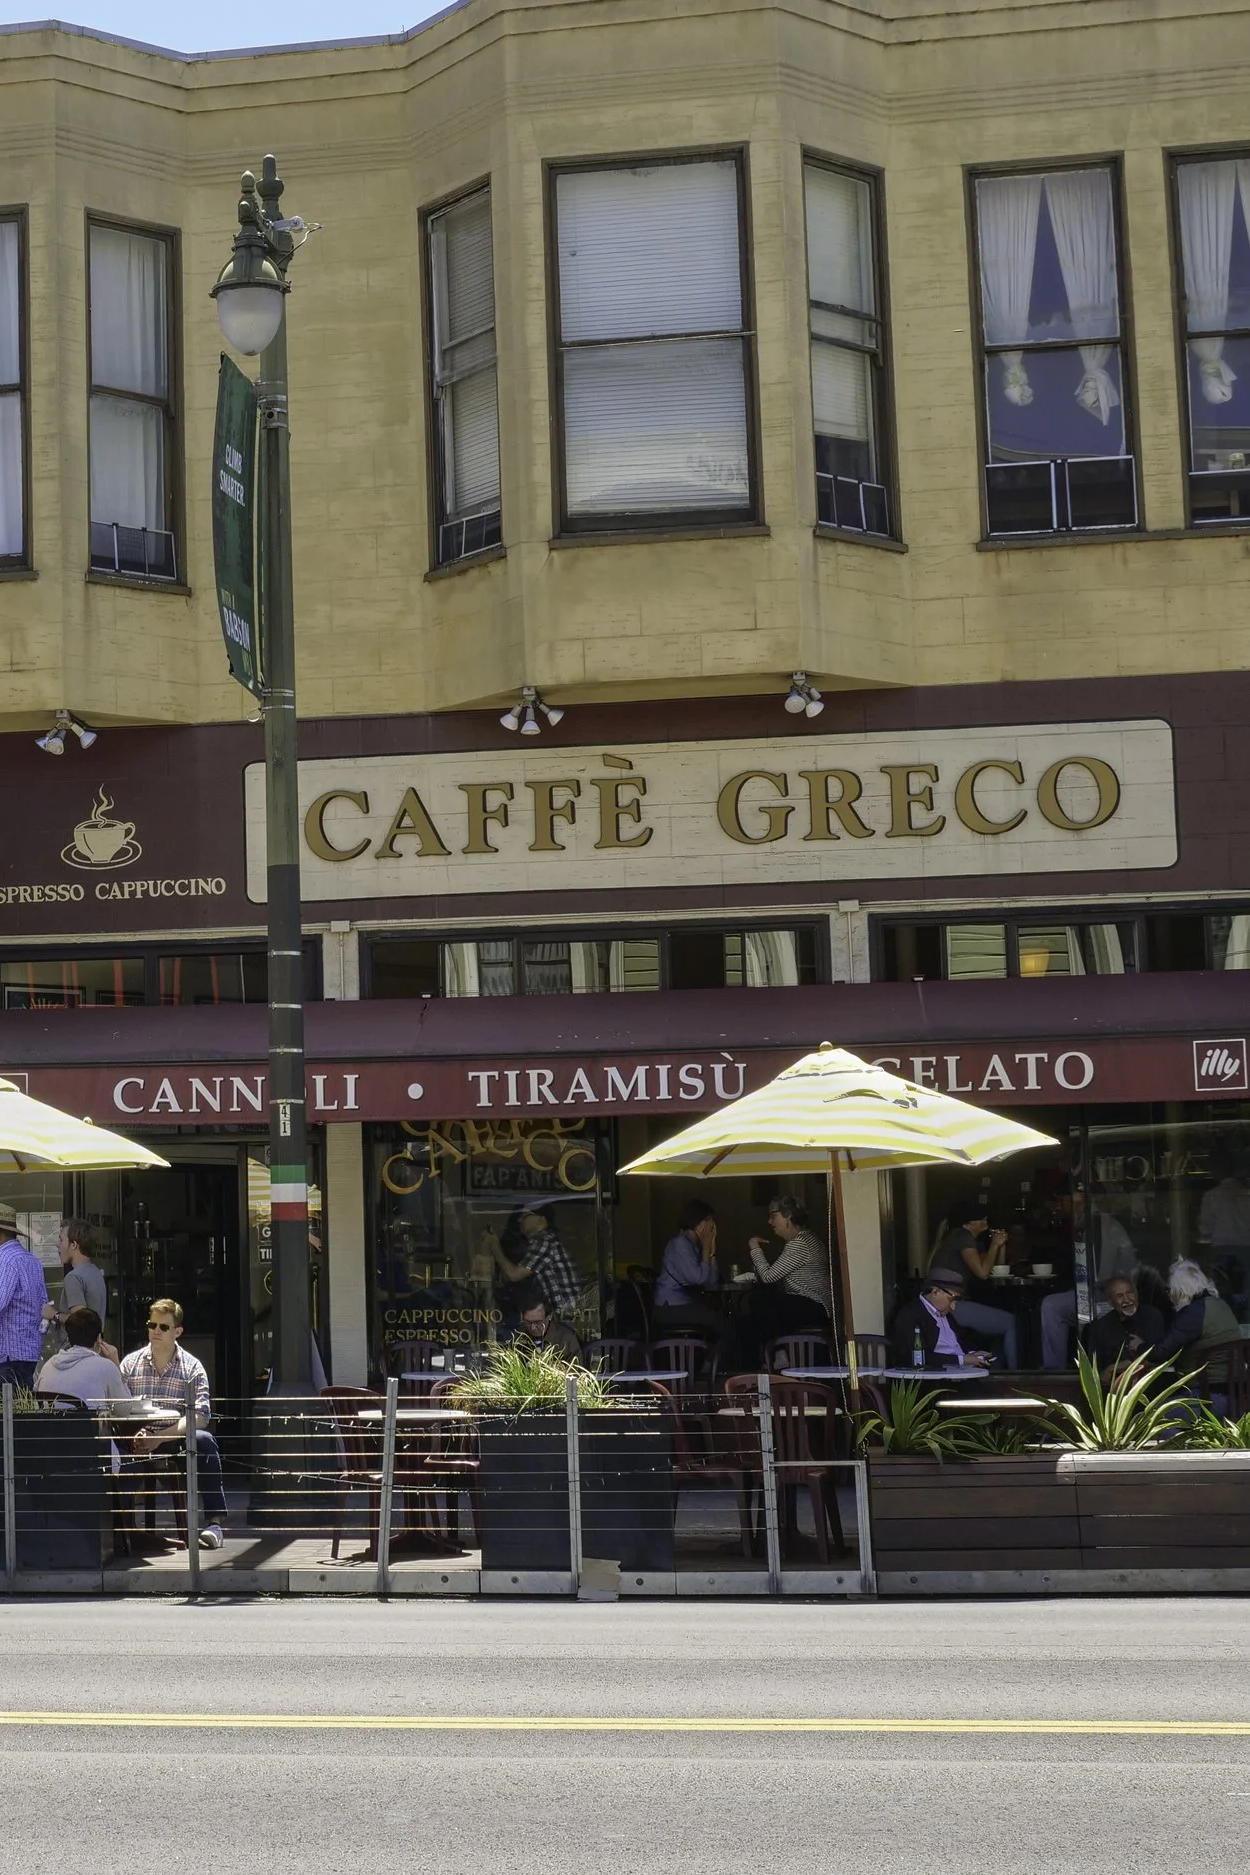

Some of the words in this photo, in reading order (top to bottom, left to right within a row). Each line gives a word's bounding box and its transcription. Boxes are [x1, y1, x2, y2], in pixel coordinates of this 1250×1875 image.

[304, 753, 654, 863] CAFFÈ
[716, 756, 1122, 846] GRECO
[95, 877, 227, 899] CAPPUCCINO
[1200, 1048, 1240, 1082] illy
[113, 1074, 360, 1113] CANNLI
[468, 1052, 747, 1107] TIRAMISÙ
[384, 1308, 503, 1325] CAPPUCCINO
[384, 1328, 472, 1345] ESPRESSO
